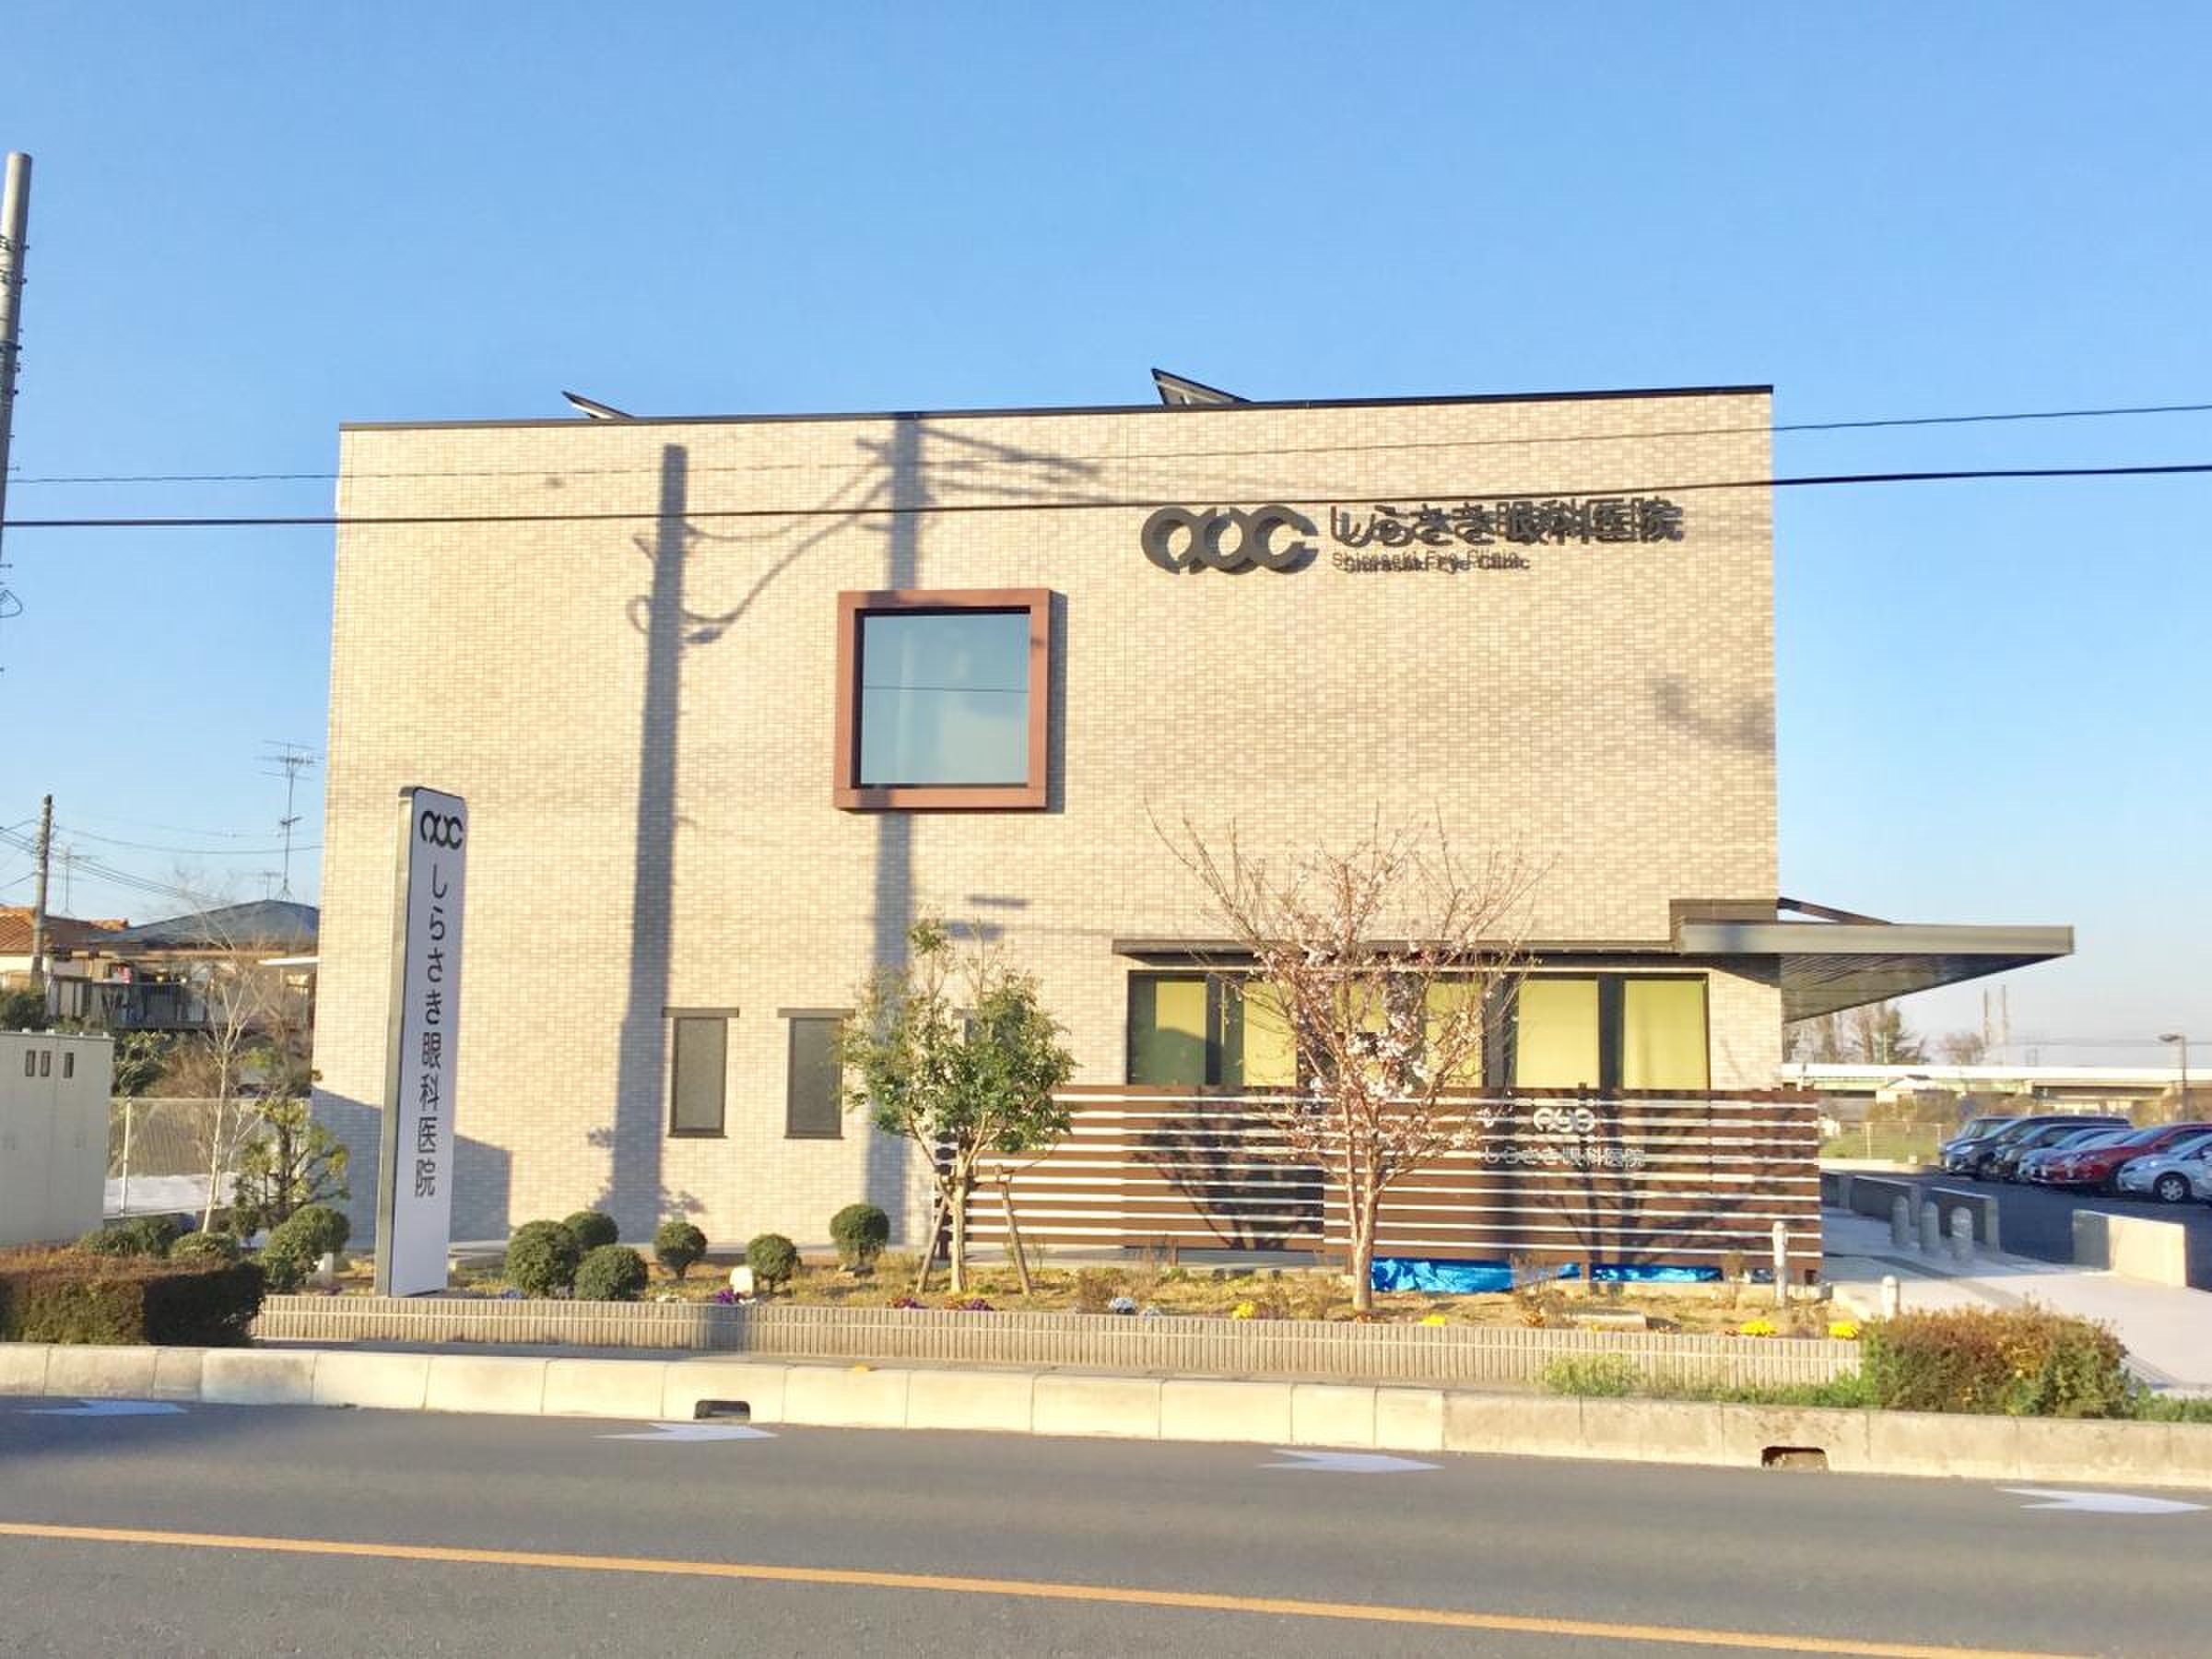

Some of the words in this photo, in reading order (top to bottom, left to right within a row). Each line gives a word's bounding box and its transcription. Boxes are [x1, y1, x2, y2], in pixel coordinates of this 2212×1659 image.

[415, 863, 448, 1198] しらさき眼科医院
